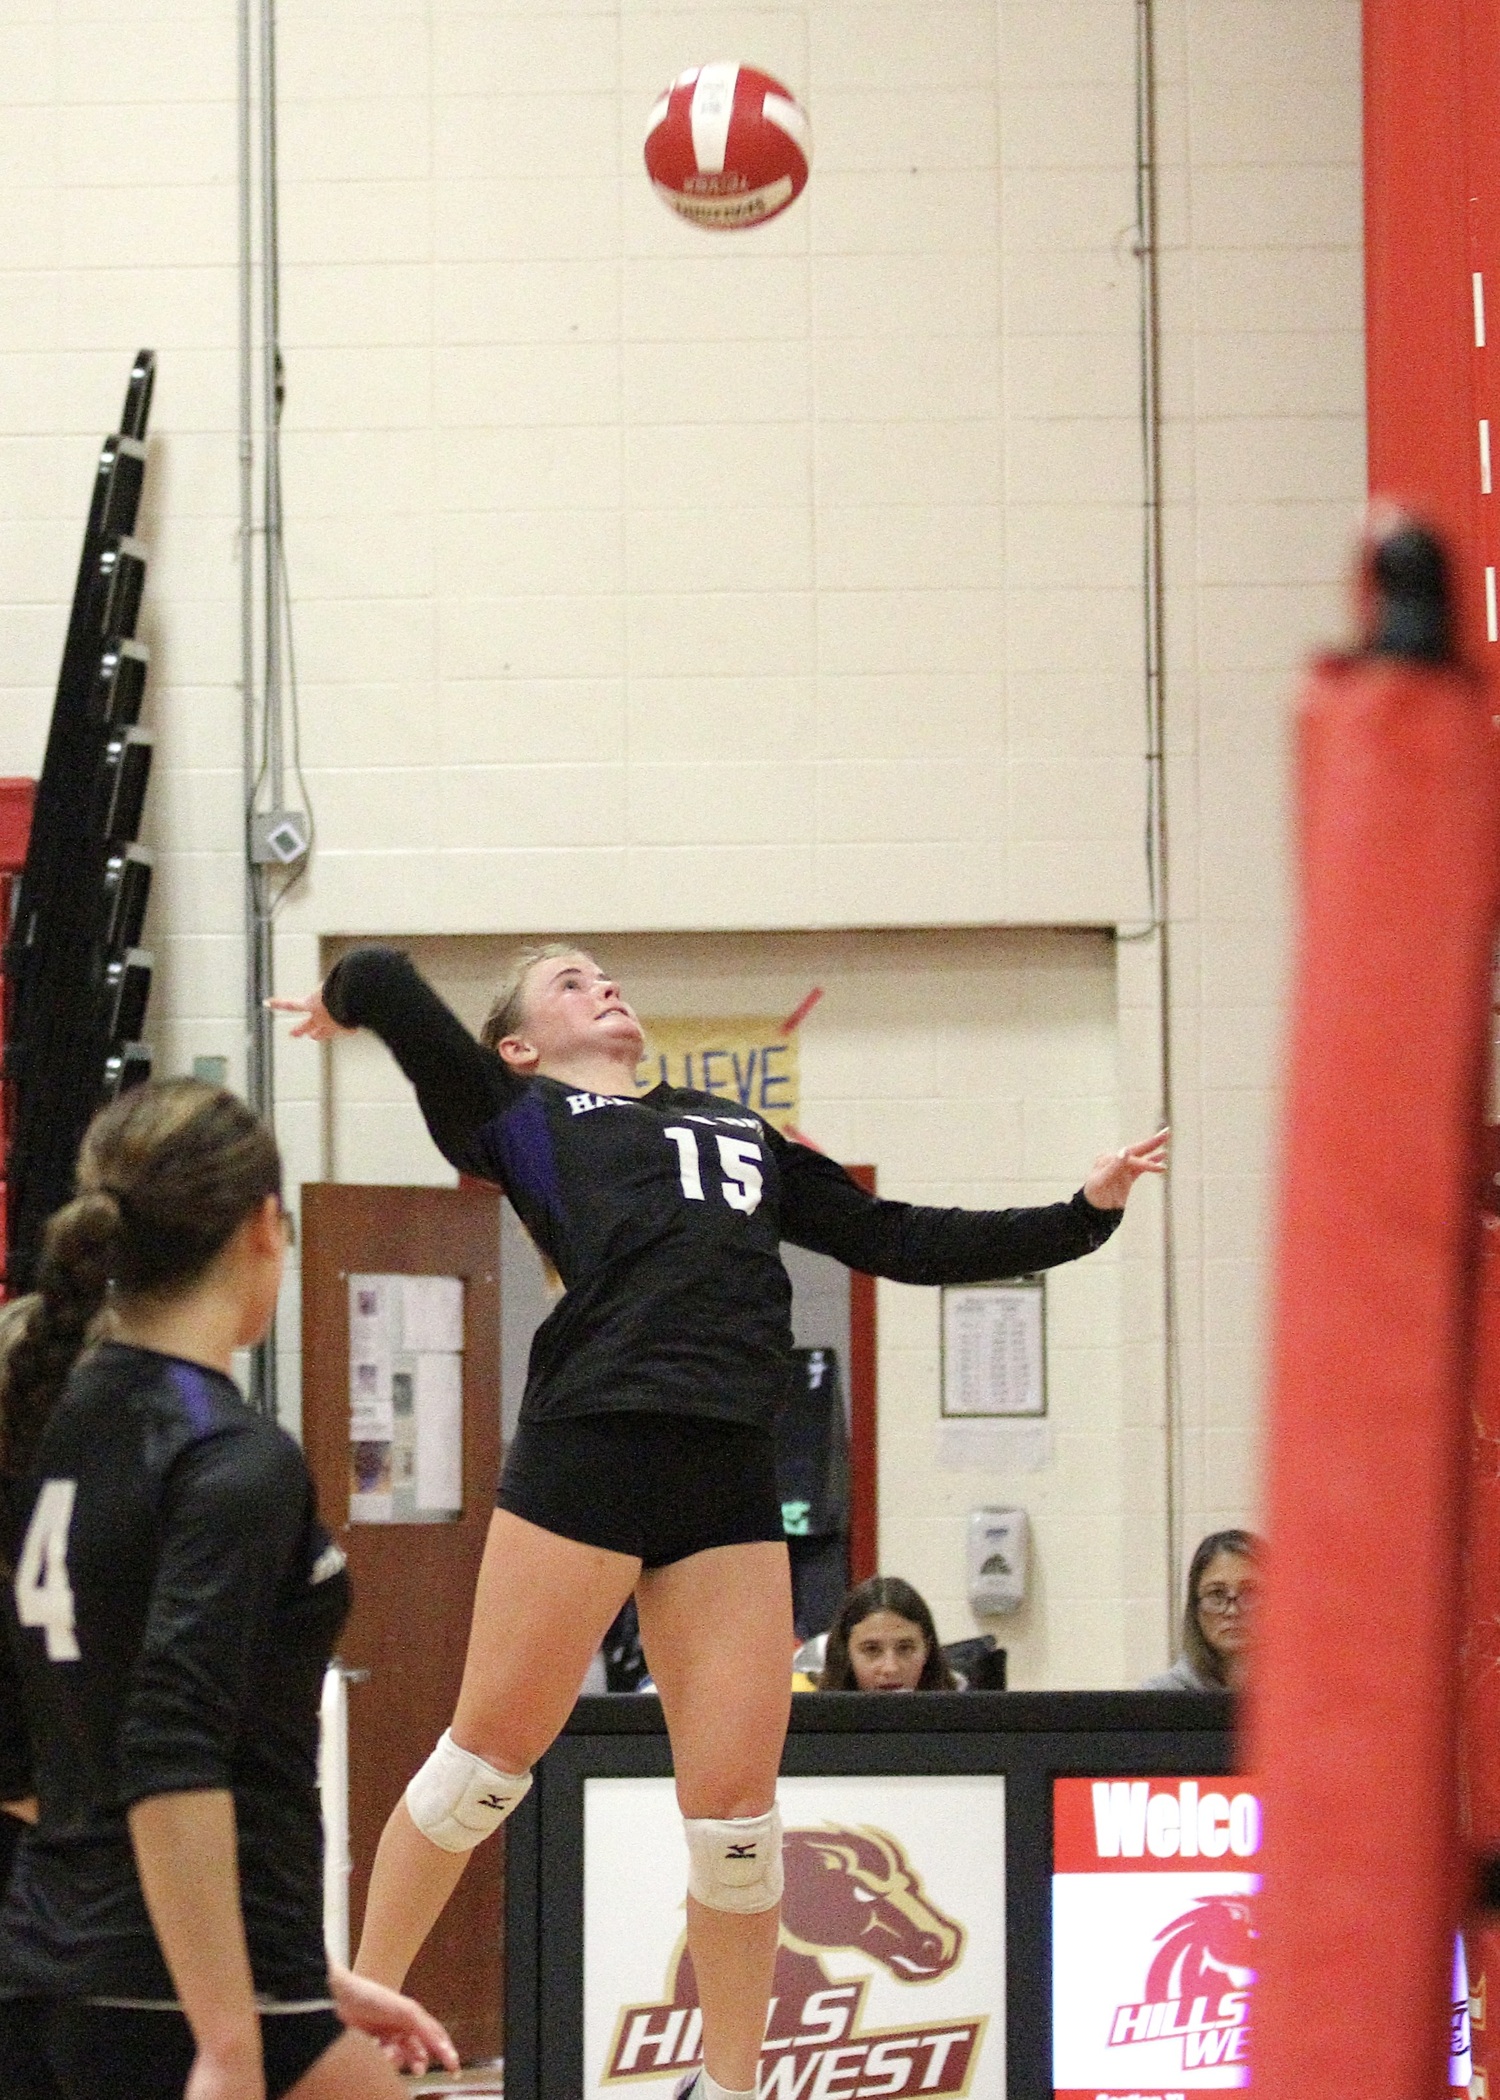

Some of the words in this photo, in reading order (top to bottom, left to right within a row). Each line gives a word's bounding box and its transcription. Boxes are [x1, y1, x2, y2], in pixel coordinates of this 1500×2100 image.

[663, 1126, 764, 1217] 15
[15, 1477, 82, 1662] 4
[1091, 1781, 1264, 1858] Welco
[617, 1986, 857, 2071] HILS
[1110, 1991, 1252, 2044] HILLS
[1184, 2026, 1251, 2069] WE
[755, 2030, 971, 2100] WEST
